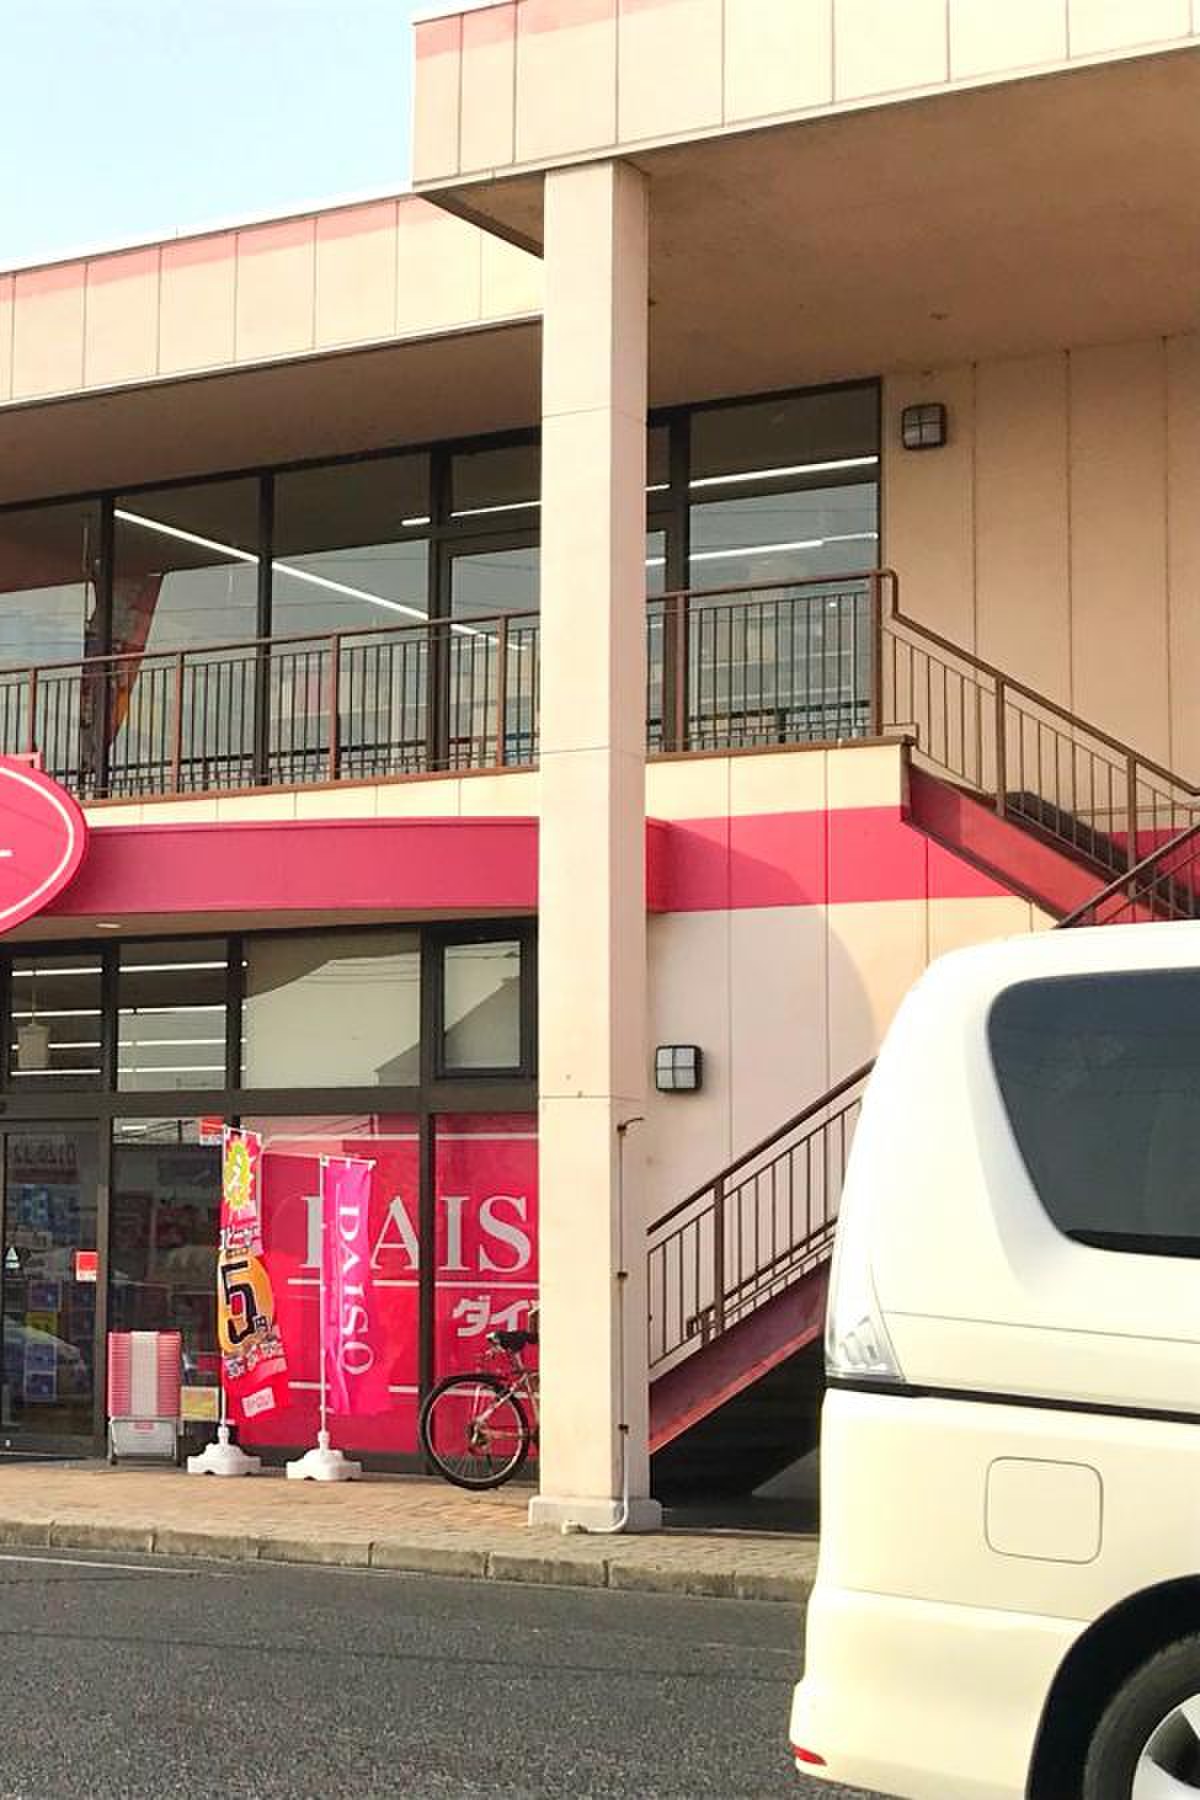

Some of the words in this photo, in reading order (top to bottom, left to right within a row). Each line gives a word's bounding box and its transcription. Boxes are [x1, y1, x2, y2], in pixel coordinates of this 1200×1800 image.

[300, 1195, 531, 1273] AIS
[338, 1206, 375, 1375] DAISO
[452, 1295, 538, 1338] ダイ
